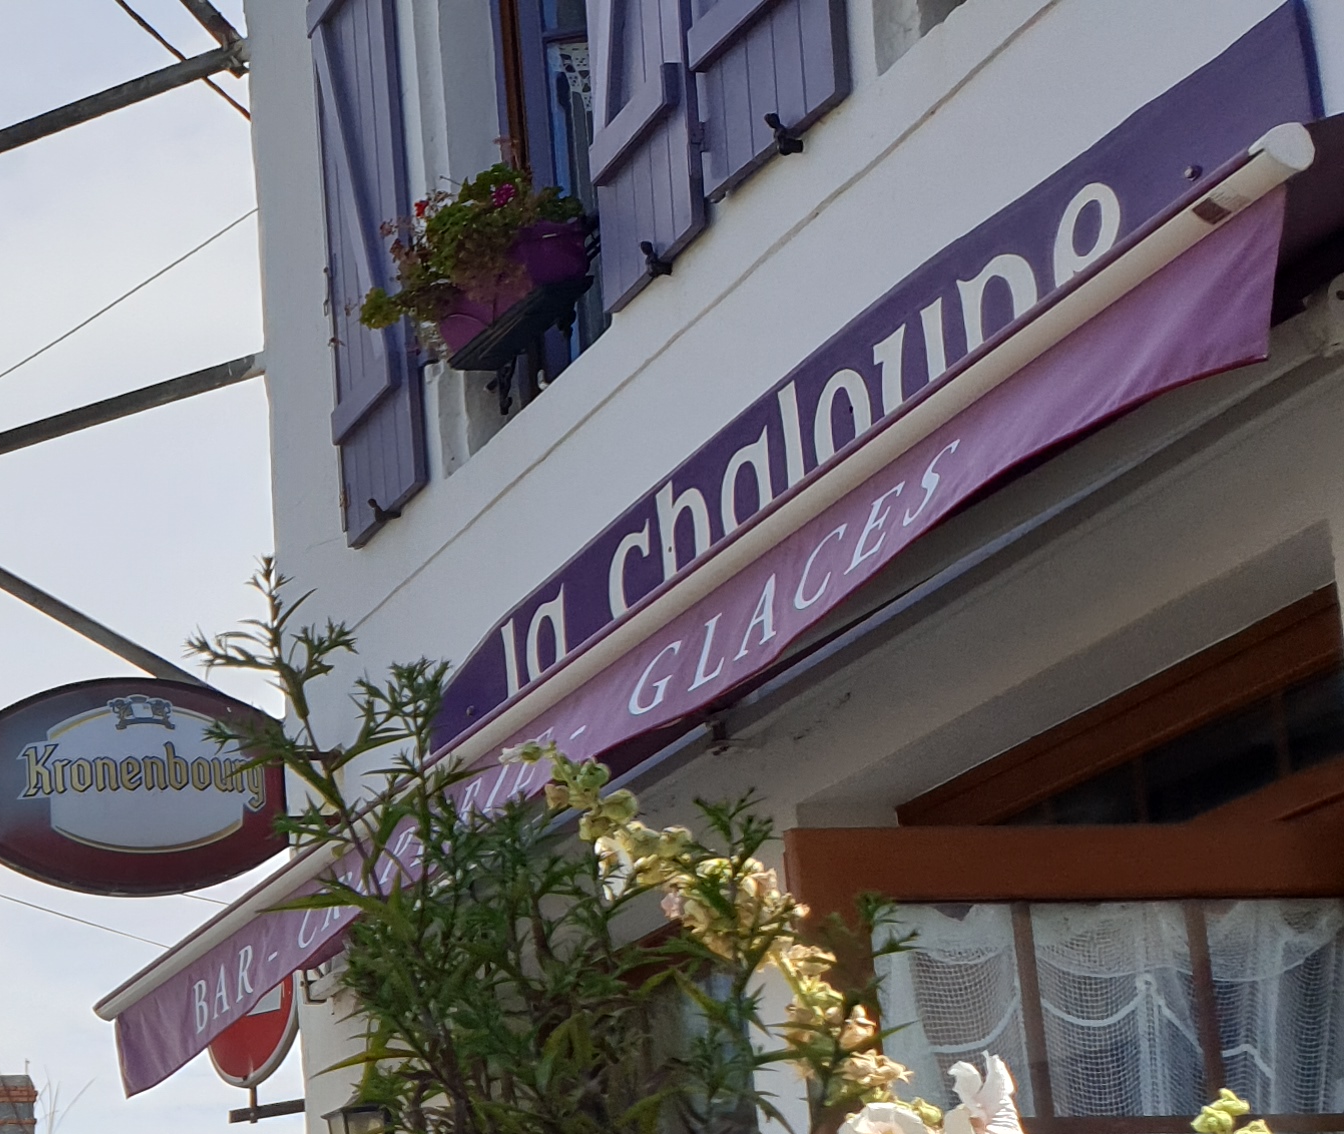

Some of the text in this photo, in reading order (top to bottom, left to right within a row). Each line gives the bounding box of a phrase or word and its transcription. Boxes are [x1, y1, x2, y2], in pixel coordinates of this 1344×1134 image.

[501, 583, 568, 699] la
[23, 740, 266, 806] Kronenbourg
[192, 944, 255, 1036] BAR
[628, 439, 961, 717] GLACES
